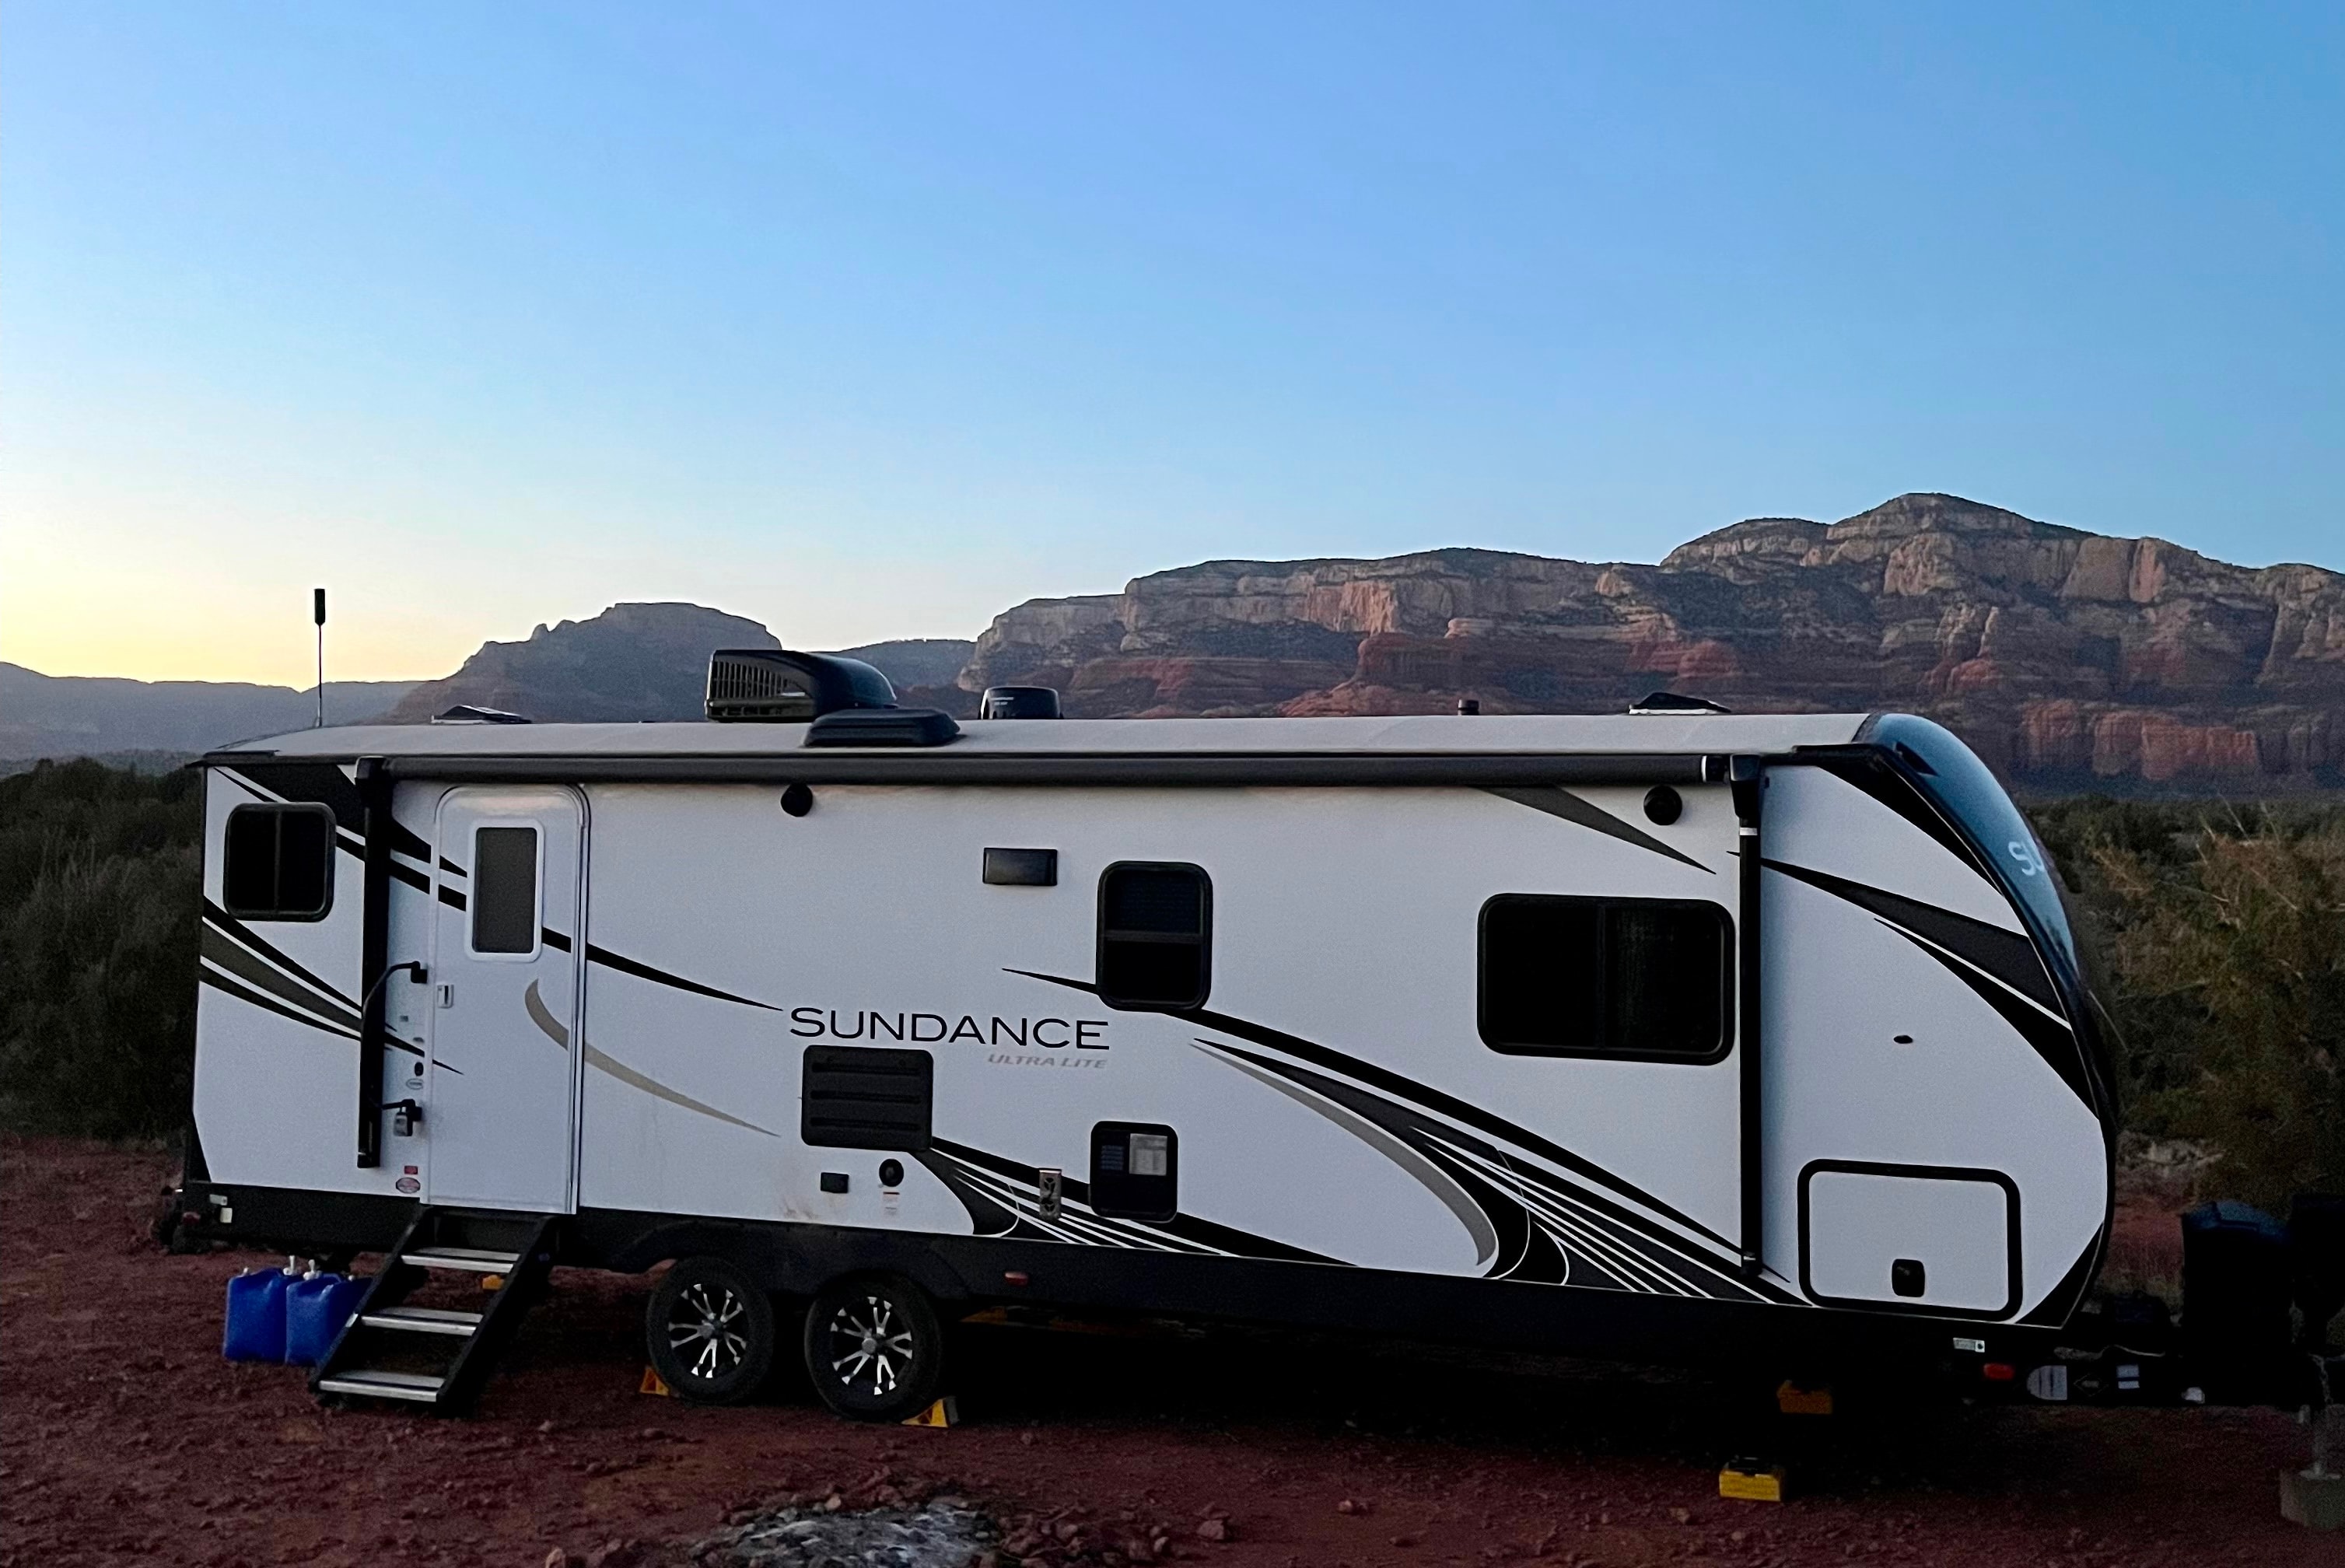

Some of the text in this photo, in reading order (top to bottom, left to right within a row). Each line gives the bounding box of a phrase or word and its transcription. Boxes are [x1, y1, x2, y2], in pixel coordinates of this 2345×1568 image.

[790, 1007, 1109, 1050] SUNDANCE
[988, 1054, 1108, 1069] ULTRA LITE
